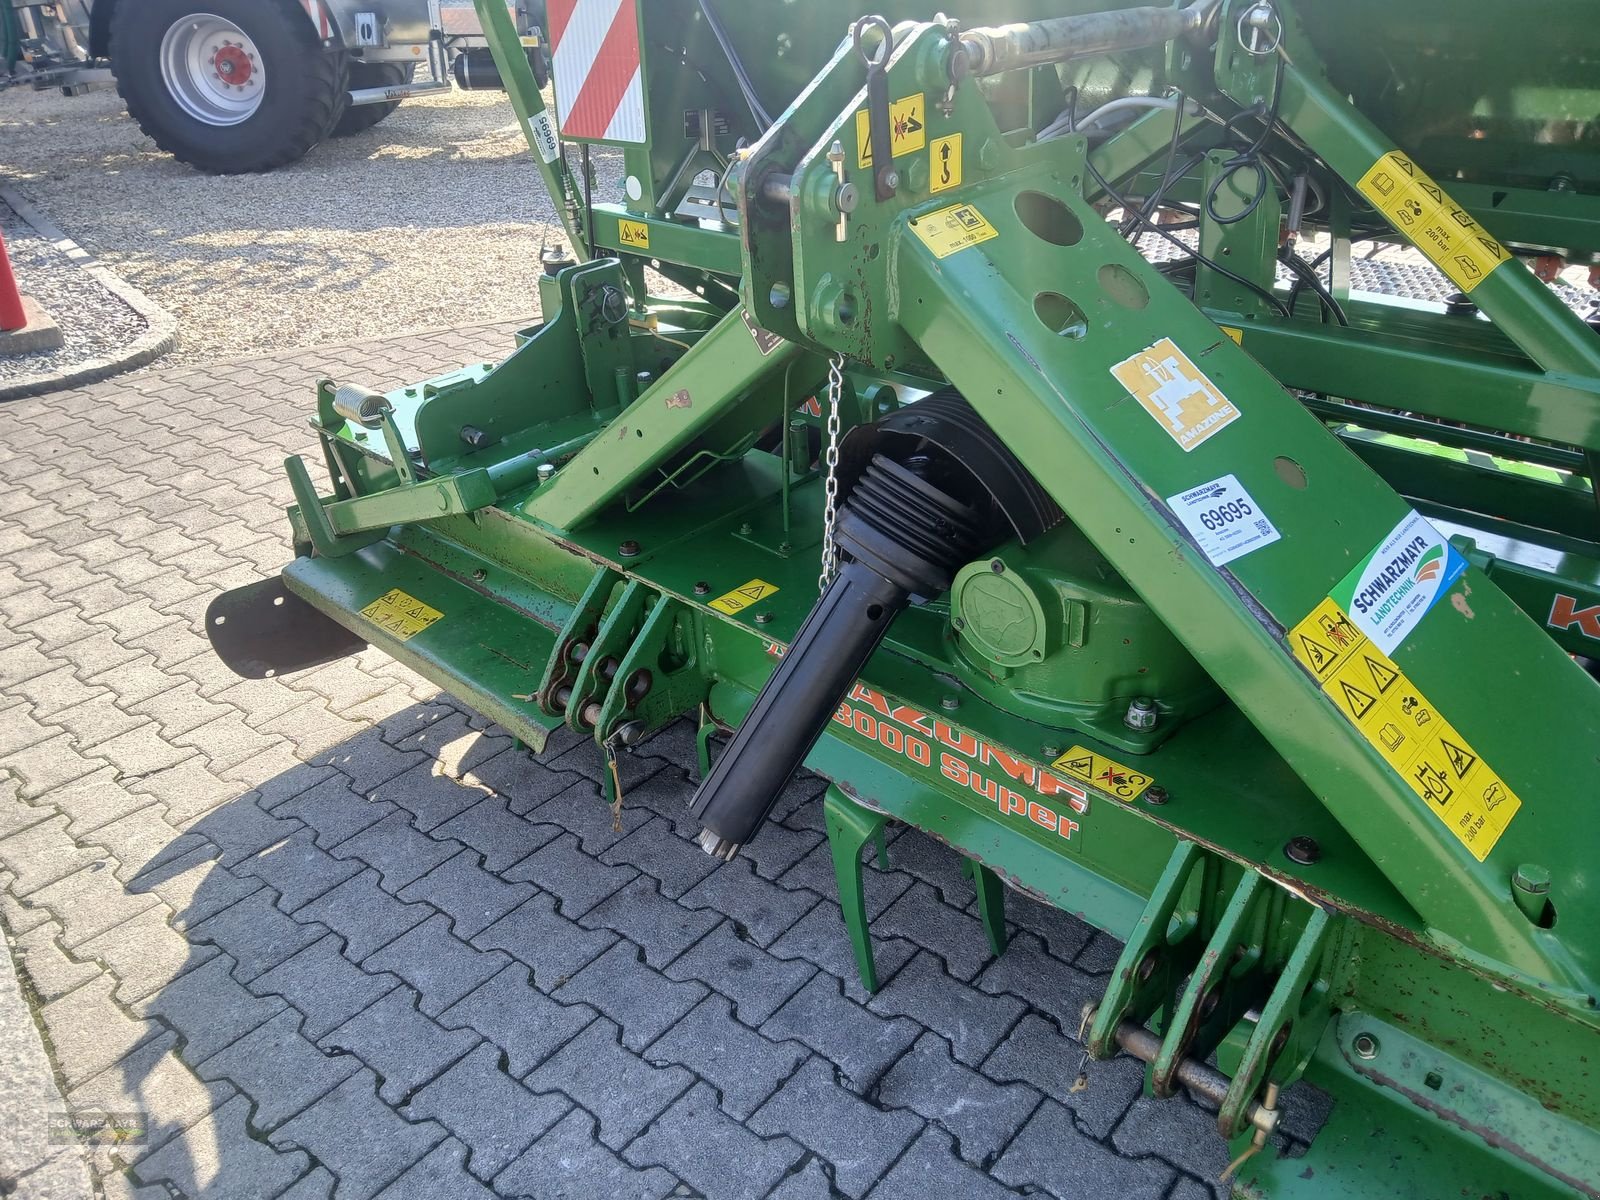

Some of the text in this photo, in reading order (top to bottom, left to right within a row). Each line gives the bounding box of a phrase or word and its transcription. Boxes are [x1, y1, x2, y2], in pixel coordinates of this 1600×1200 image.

[539, 117, 556, 150] 69695
[1425, 228, 1450, 252] 200 bar
[1180, 404, 1233, 445] AMAZONE
[1181, 482, 1220, 502] SCHWARZMAYR
[1199, 497, 1252, 531] 69695
[1353, 535, 1428, 614] SCHWARZMAYR
[1370, 577, 1416, 626] LANDTECHNIK
[832, 702, 1079, 840] 3000 Super
[1464, 815, 1486, 843] 200 bar
